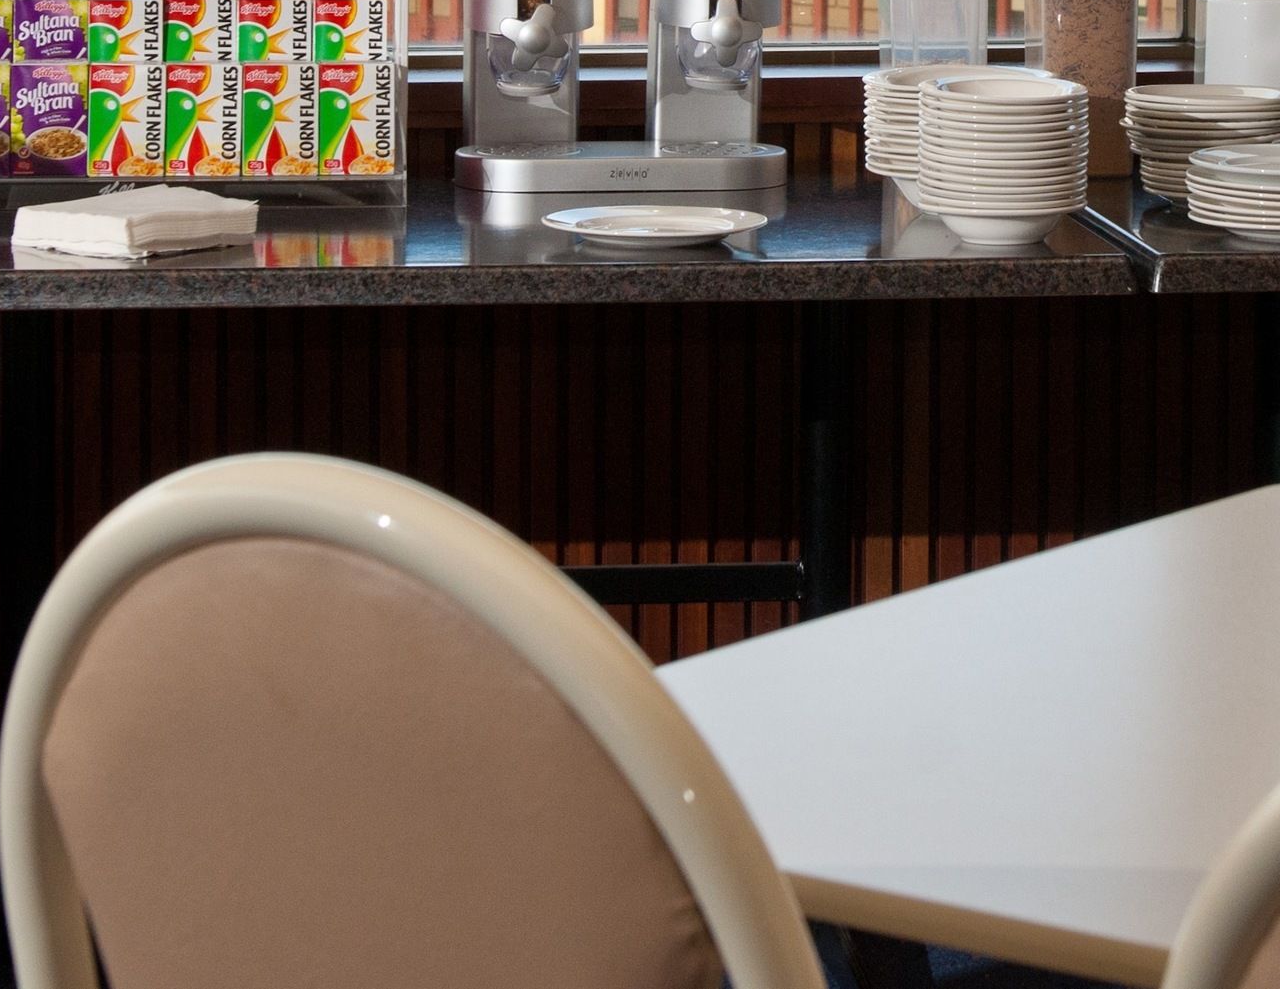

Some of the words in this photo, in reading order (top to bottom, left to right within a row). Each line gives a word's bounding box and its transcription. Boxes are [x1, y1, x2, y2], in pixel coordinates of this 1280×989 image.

[92, 3, 127, 18] Kellogg's
[144, 0, 159, 51] FLAKES
[240, 3, 275, 17] Kellogg's
[293, 0, 307, 50] FLAKES
[317, 3, 352, 17] Kellogg's
[369, 0, 383, 50] FLAKES
[18, 14, 79, 41] Sultana
[36, 29, 74, 47] Bran
[93, 69, 128, 84] Kellogg's
[147, 66, 162, 118] FLAKES
[169, 69, 204, 84] Kellogg's
[222, 66, 238, 118] FLAKES
[246, 69, 281, 83] Kellogg's
[300, 66, 315, 117] FLAKES
[322, 68, 357, 83] Kellogg's
[376, 65, 391, 117] FLAKES
[16, 82, 79, 109] Sultana
[34, 96, 73, 115] Bran
[145, 121, 161, 160] CORN
[221, 121, 237, 160] CORN
[299, 120, 314, 159] CORN
[375, 119, 391, 158] CORN
